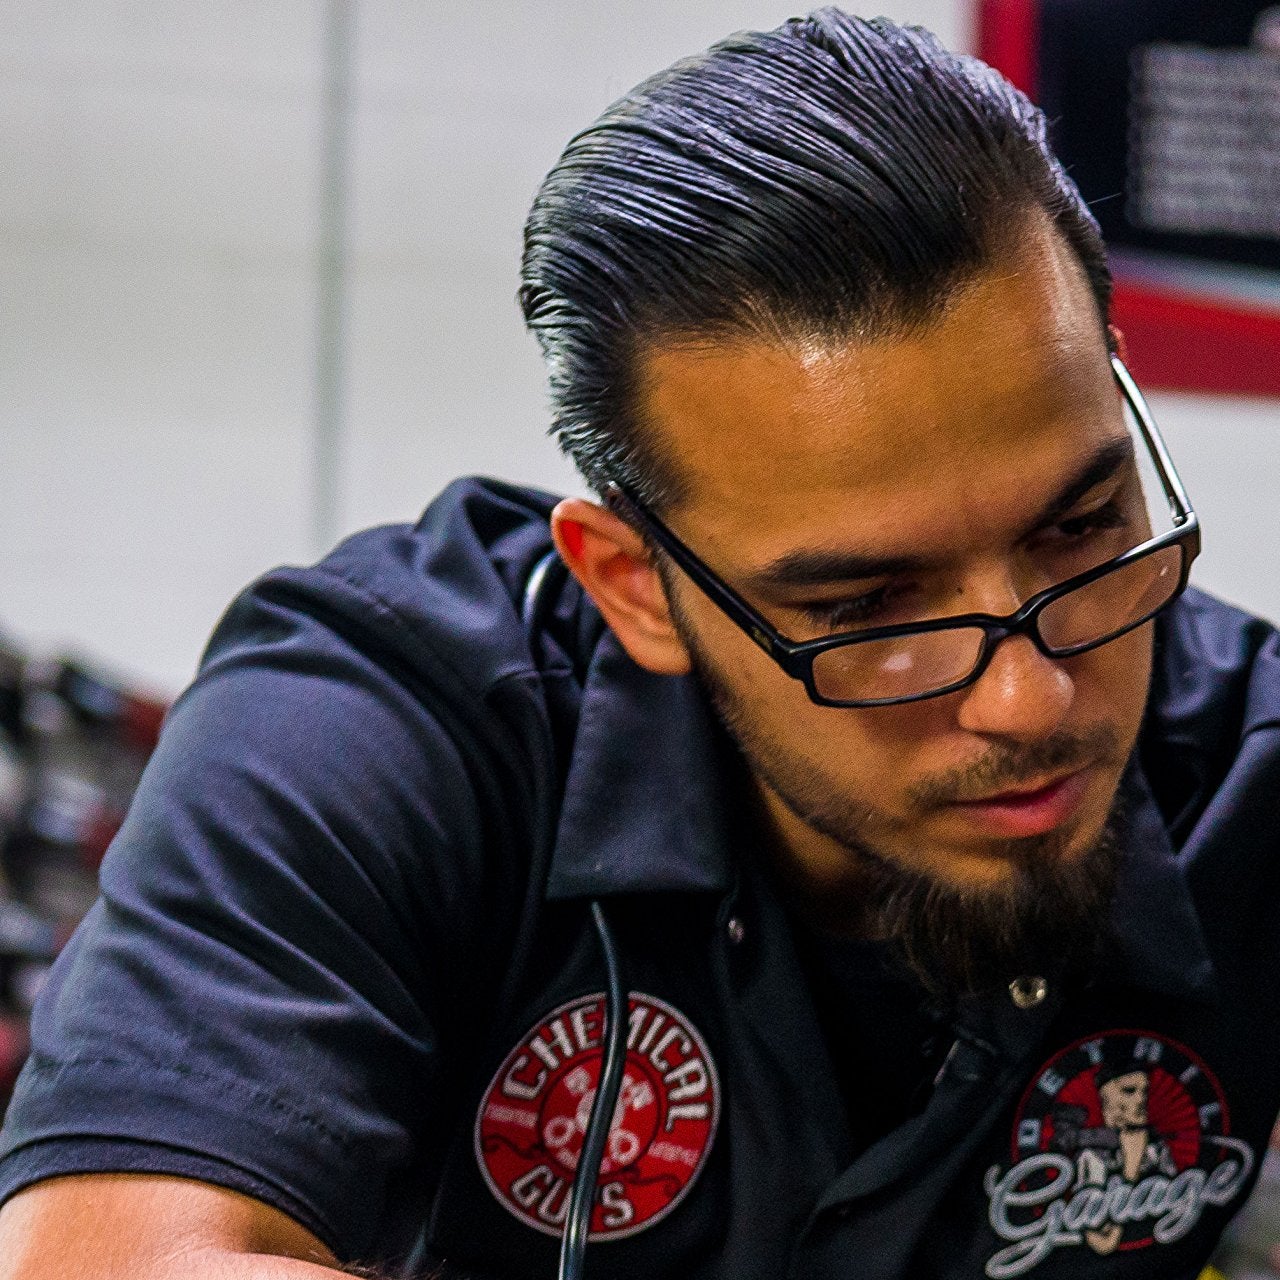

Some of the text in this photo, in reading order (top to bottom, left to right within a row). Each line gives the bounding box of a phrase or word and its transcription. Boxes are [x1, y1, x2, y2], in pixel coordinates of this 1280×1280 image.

[1017, 1037, 1220, 1149] DETAIL
[511, 1164, 634, 1227] GUS
[983, 1135, 1256, 1280] Garage
